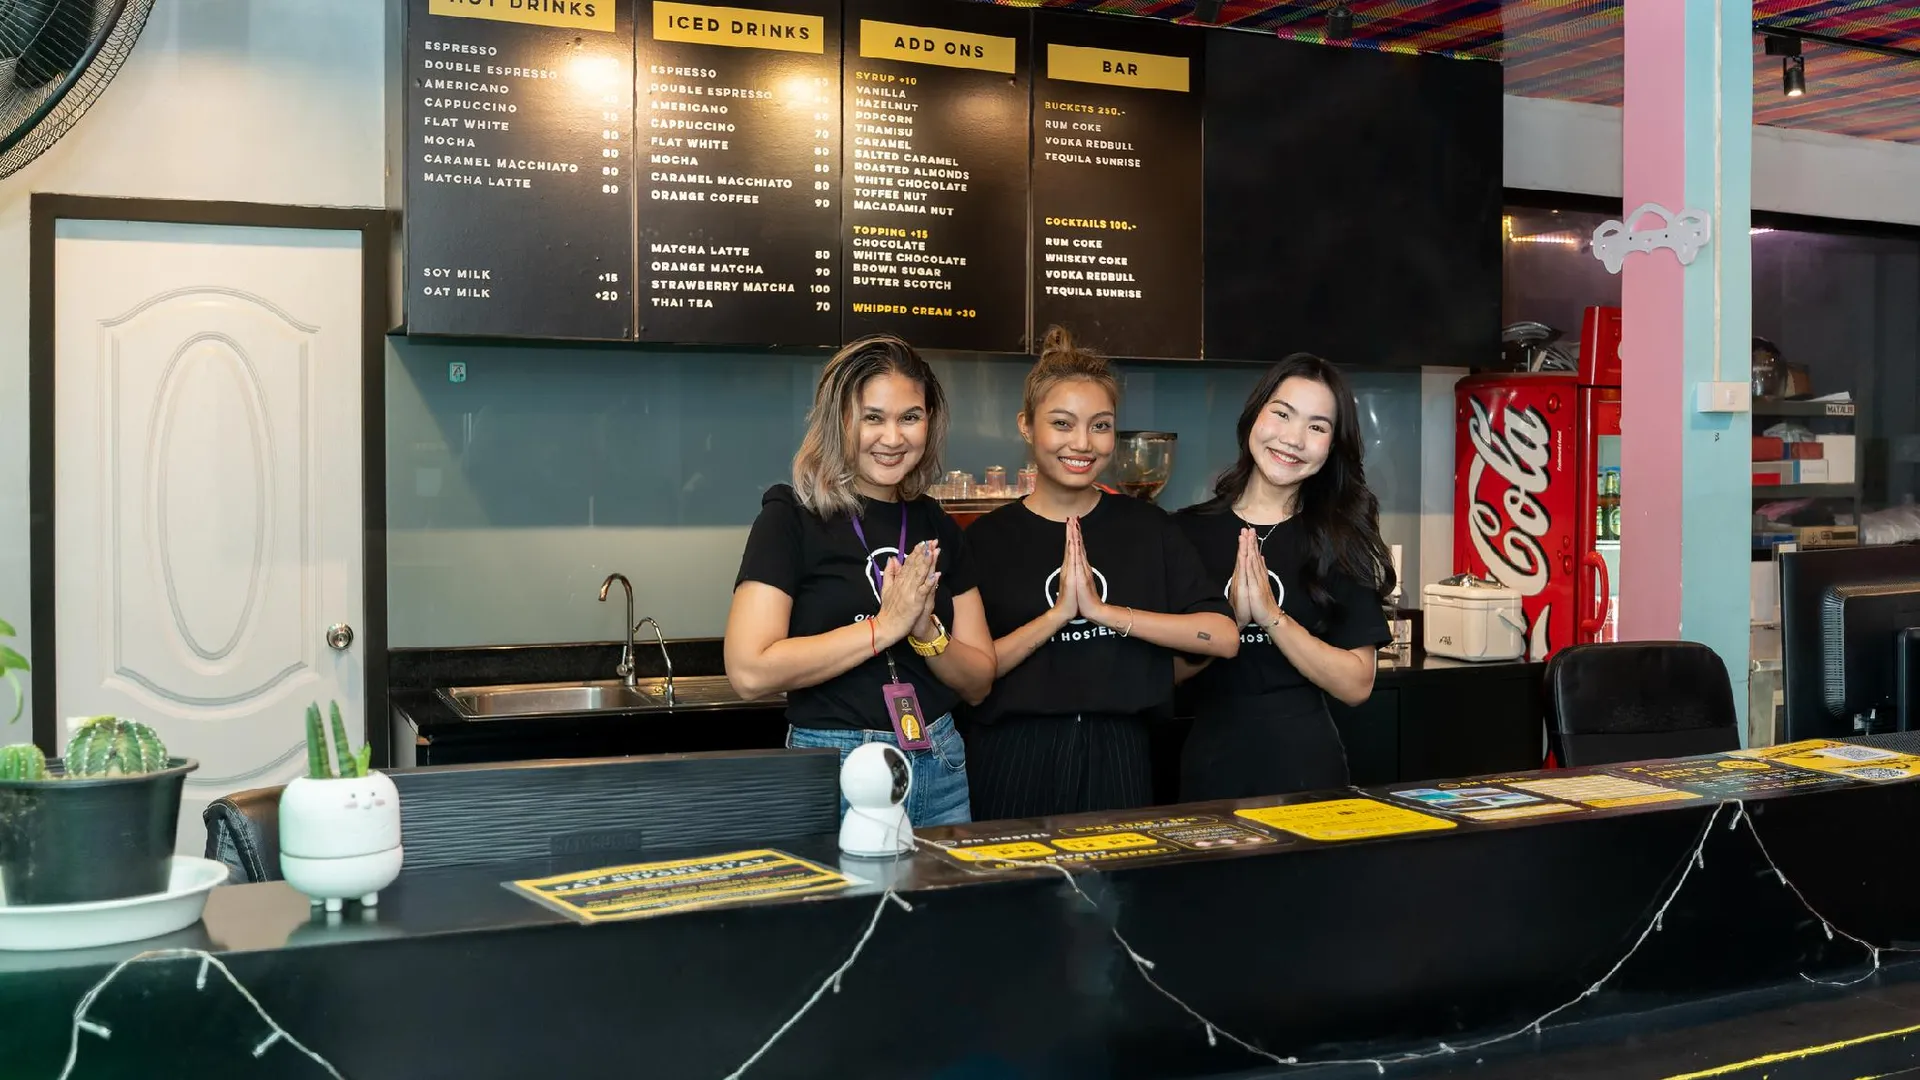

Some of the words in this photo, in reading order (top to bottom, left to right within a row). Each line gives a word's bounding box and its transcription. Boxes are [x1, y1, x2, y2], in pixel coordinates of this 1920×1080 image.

[511, 0, 595, 17] DRINKS
[669, 15, 719, 31] ICED
[731, 21, 810, 39] DRINKS
[425, 41, 497, 56] ESPRESSO
[894, 37, 934, 52] ADD
[945, 43, 984, 58] ONS
[425, 60, 481, 73] DOUBLE
[488, 66, 557, 79] ESPRESSO
[651, 65, 716, 78] ESPRESSO
[1103, 61, 1138, 75] BAR
[856, 72, 894, 82] SYRUP
[900, 77, 917, 85] +10
[425, 79, 509, 94] AMERICANO
[650, 84, 702, 95] DOUBLE
[708, 88, 772, 99] ESPRESSO
[856, 86, 906, 98] VANILLA
[424, 98, 517, 113] CAPPUCCINO
[651, 101, 728, 114] AMERICANO
[856, 98, 918, 112] HAZELNUT
[1045, 102, 1094, 113] BUCKETS
[1098, 107, 1126, 115] 250.-
[856, 111, 912, 124] POPCORN
[424, 117, 457, 128] FLAT
[464, 120, 509, 131] WHITE
[603, 130, 619, 140] 80
[651, 119, 735, 132] CAPPUCCINO
[815, 129, 829, 139] 70
[855, 124, 912, 137] TIRAMISU
[1045, 120, 1067, 129] RUM
[1073, 123, 1101, 131] COKE
[424, 136, 475, 147] MOCHA
[603, 148, 619, 158] 80
[651, 137, 682, 147] FLAT
[687, 139, 728, 150] WHITE
[814, 146, 829, 156] 80
[855, 137, 911, 150] CARAMEL
[1045, 137, 1082, 147] VODKA
[1086, 139, 1134, 150] REDBULL
[424, 154, 491, 168] CARAMEL
[497, 159, 578, 173] MACCHIATO
[603, 167, 619, 176] 80
[651, 155, 698, 166] MOCHA
[815, 164, 829, 173] 80
[855, 150, 899, 161] SALTED
[904, 153, 958, 166] CARAMEL
[1045, 153, 1091, 164] TEQUILA
[1096, 157, 1141, 168] SUNRISE
[855, 163, 909, 175] ROASTED
[914, 167, 969, 180] ALMONDS
[424, 173, 482, 185] MATCHA
[488, 177, 531, 188] LATTE
[602, 185, 618, 194] 80
[651, 172, 713, 184] CARAMEL
[718, 176, 792, 189] MACCHIATO
[815, 181, 829, 191] 80
[854, 176, 893, 186] WHITE
[898, 179, 967, 192] CHOCOLATE
[651, 190, 704, 201] ORANGE
[710, 193, 759, 204] COFFEE
[815, 199, 830, 208] 90
[854, 188, 899, 199] TOFFEE
[904, 192, 927, 201] NUT
[854, 201, 926, 214] MACADAMIA
[931, 207, 954, 216] NUT
[1046, 217, 1106, 228] COCKTAILS
[1110, 221, 1136, 230] 100.-
[854, 226, 906, 237] TOPPING
[911, 230, 928, 238] +15
[853, 239, 925, 251] CHOCOLATE
[1046, 238, 1068, 247] RUM
[1073, 240, 1102, 248] COKE
[651, 244, 705, 254] MATCHA
[710, 247, 749, 256] LATTE
[815, 250, 830, 259] 80
[853, 252, 892, 262] WHITE
[897, 254, 966, 266] CHOCOLATE
[1046, 254, 1095, 263] WHISKEY
[1099, 257, 1127, 265] COKE
[424, 268, 450, 278] SOY
[457, 269, 491, 280] MILK
[599, 273, 618, 283] +15
[651, 262, 705, 272] ORANGE
[711, 264, 763, 274] MATCHA
[816, 268, 830, 277] 90
[853, 264, 897, 274] BROWN
[902, 266, 941, 277] SUGAR
[1046, 270, 1083, 280] VODKA
[1086, 272, 1135, 282] REDBULL
[651, 280, 738, 291] STRAWBERRY
[743, 283, 795, 292] MATCHA
[810, 284, 830, 293] 100
[853, 277, 899, 287] BUTTER
[904, 279, 951, 290] SCOTCH
[424, 287, 450, 296] OAT
[457, 288, 490, 298] MILK
[595, 291, 618, 301] +20
[1046, 286, 1092, 296] TEQUILA
[1096, 289, 1142, 298] SUNRISE
[652, 298, 683, 307] THAI
[688, 299, 713, 308] TEA
[816, 302, 830, 311] 70
[853, 303, 907, 314] WHIPPED
[912, 307, 952, 316] CREAM
[957, 309, 976, 317] +30
[1469, 395, 1550, 597] Cola
[1061, 626, 1116, 641] HOSTEL
[1239, 633, 1272, 646] HOST
